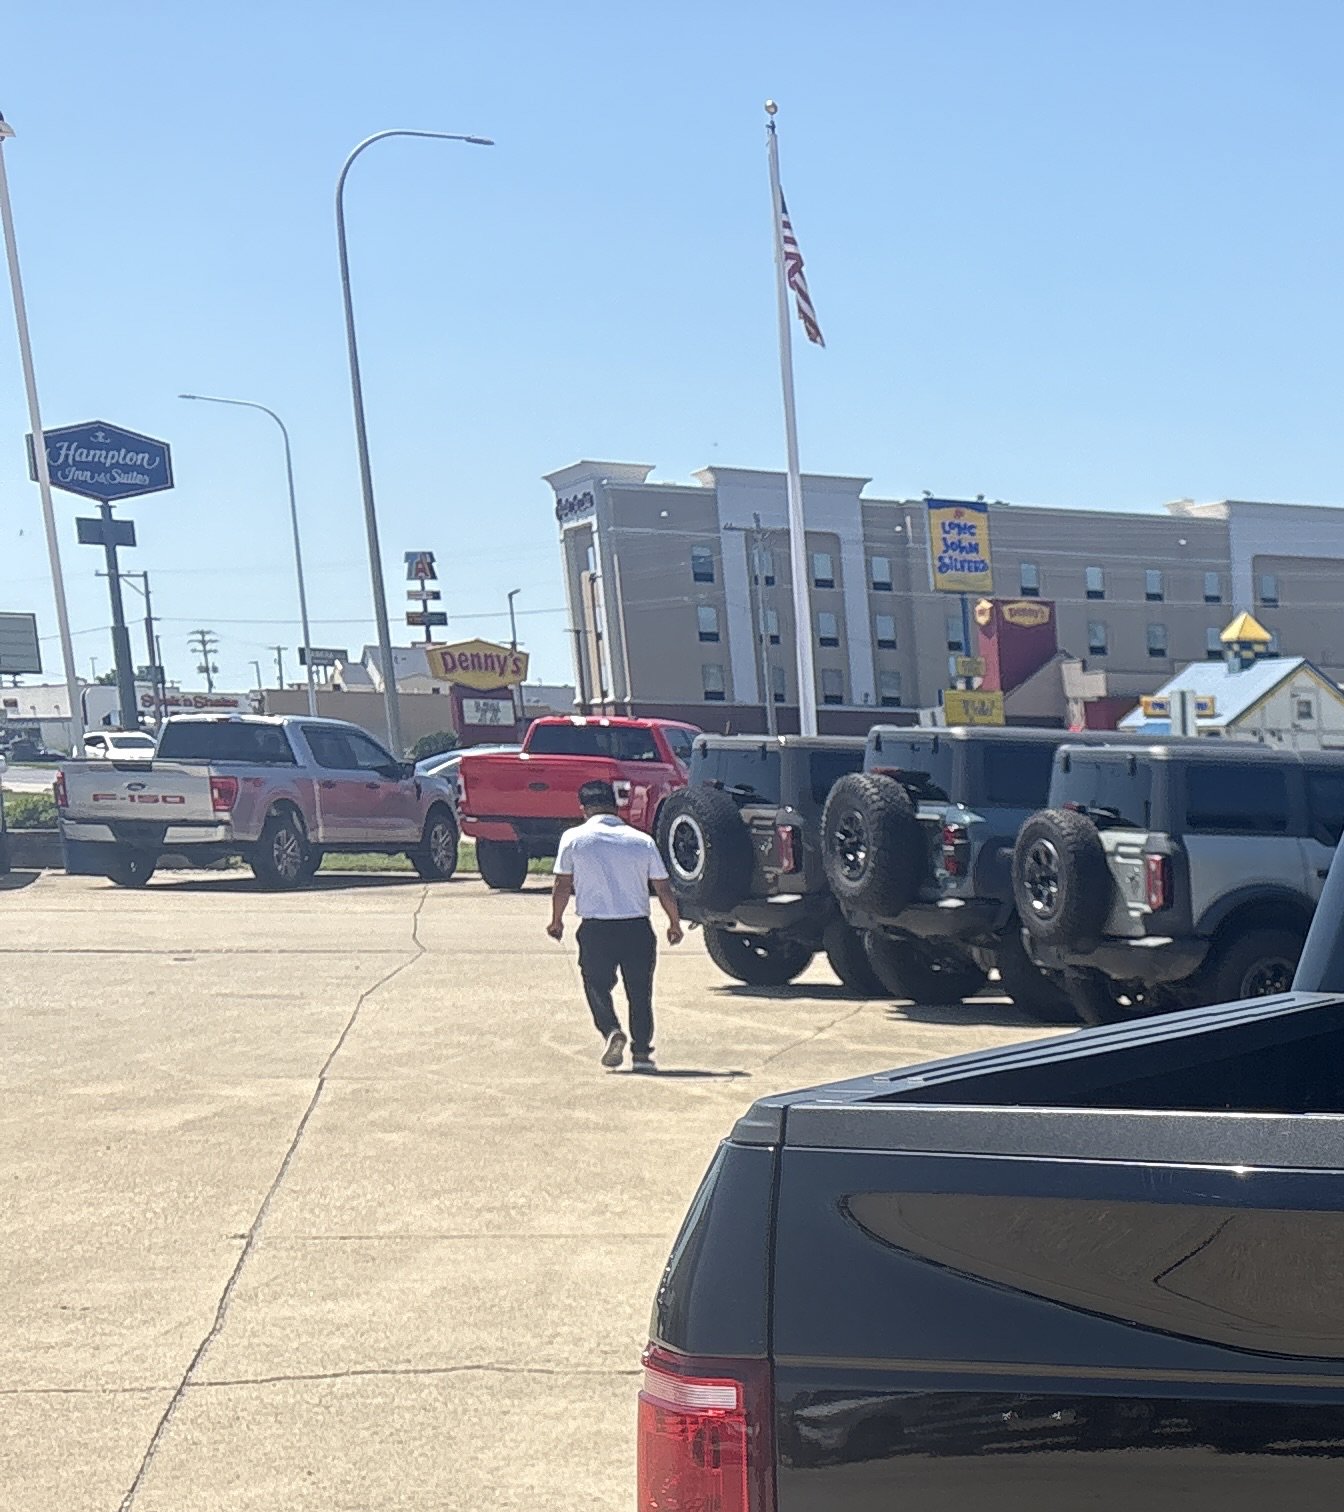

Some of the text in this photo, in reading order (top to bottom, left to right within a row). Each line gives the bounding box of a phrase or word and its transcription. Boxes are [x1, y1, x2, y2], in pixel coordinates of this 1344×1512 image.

[47, 442, 160, 469] Hampton
[58, 466, 97, 483] Inn
[107, 468, 149, 486] Suites
[440, 651, 521, 677] Denny's
[93, 793, 185, 804] F-150
